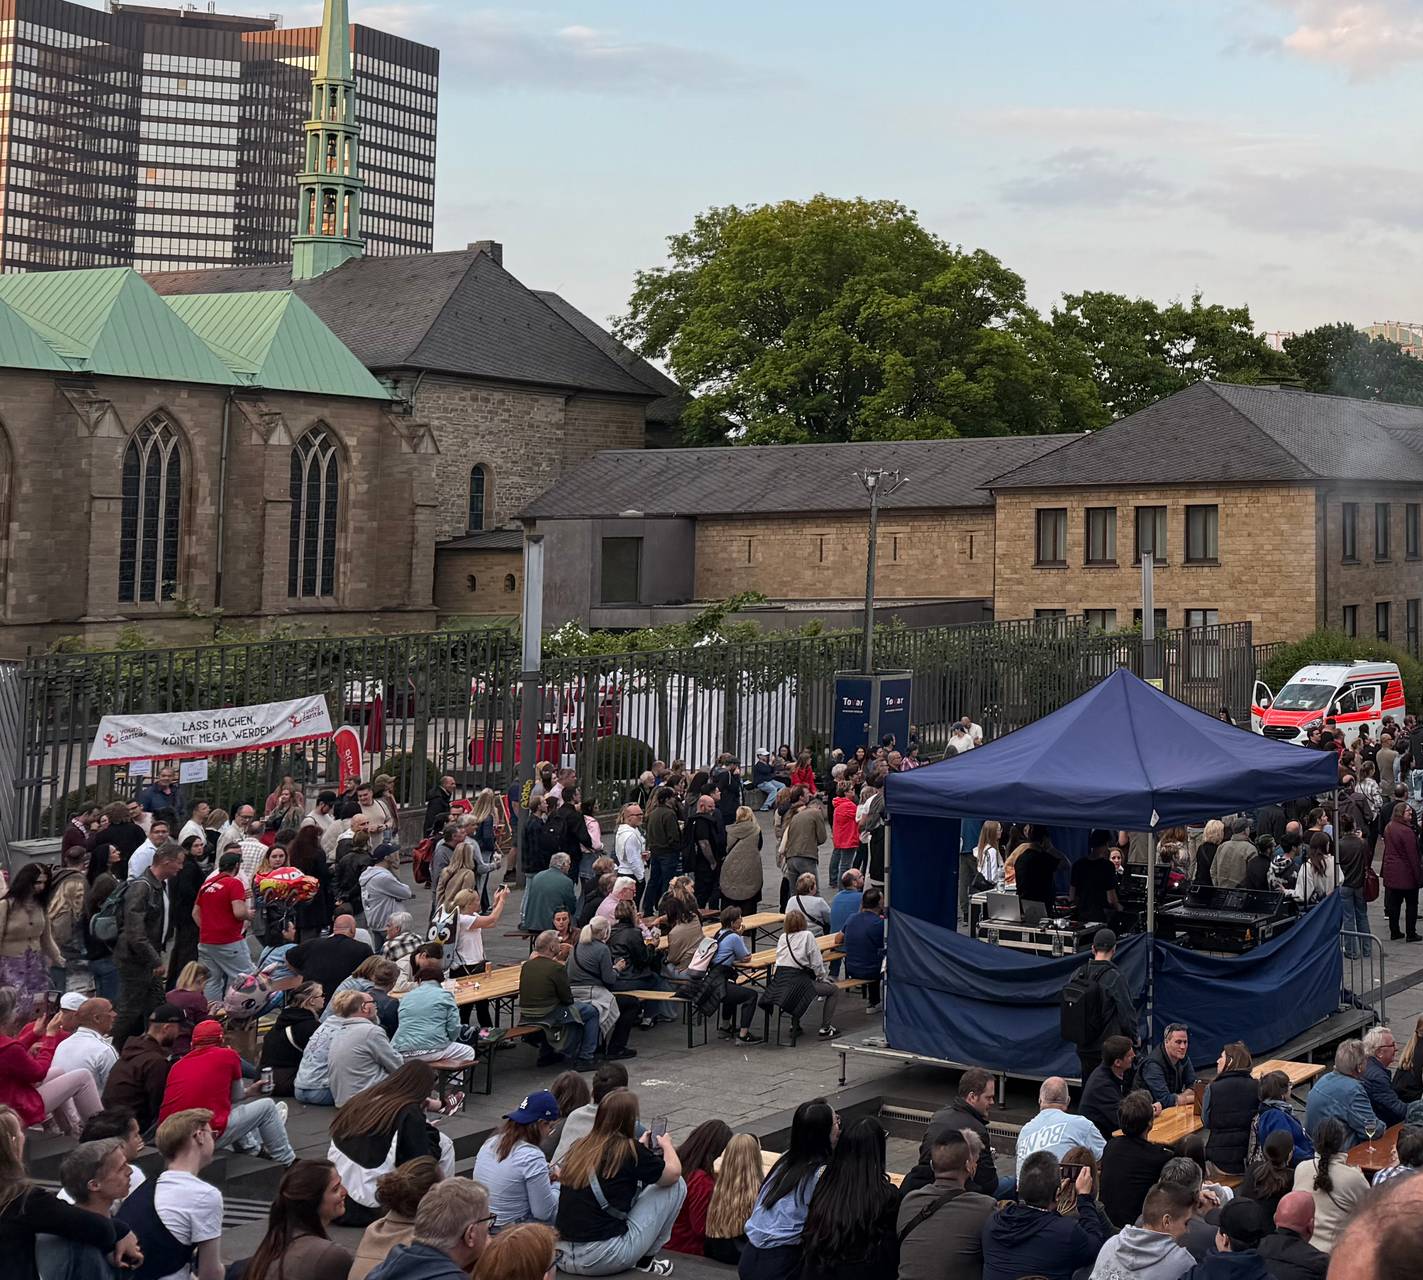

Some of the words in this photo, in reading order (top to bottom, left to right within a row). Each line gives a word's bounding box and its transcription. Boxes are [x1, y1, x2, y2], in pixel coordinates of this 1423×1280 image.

[842, 697, 864, 707] Tovar
[885, 697, 904, 706] Tovar
[182, 721, 208, 732] LASS
[213, 716, 256, 729] MACHEN,
[161, 733, 195, 746] KÖNNT
[200, 731, 228, 743] MEGA
